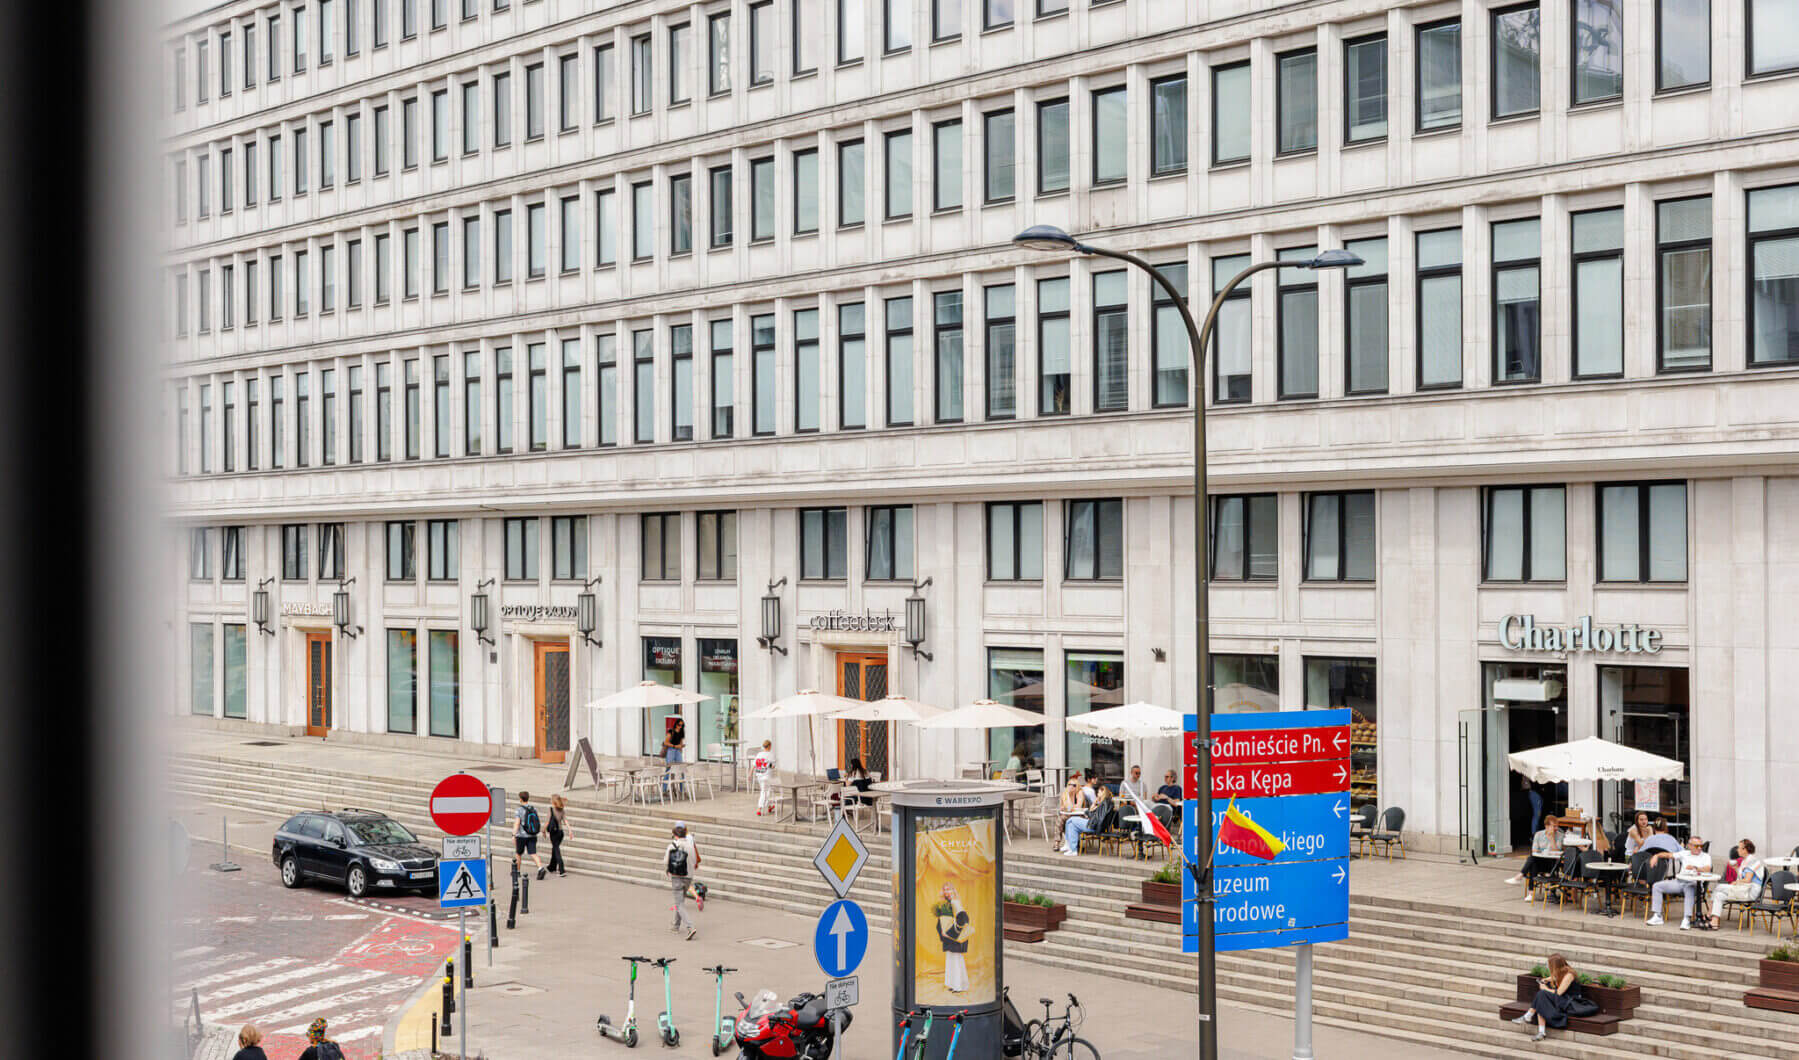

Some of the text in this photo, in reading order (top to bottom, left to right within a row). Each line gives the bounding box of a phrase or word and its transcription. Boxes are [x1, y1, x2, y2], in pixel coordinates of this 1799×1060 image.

[809, 607, 896, 631] coffeedesk
[1498, 614, 1663, 653] Charlotte
[1192, 733, 1326, 758] ódmieście Pn.
[1251, 769, 1292, 794] Kępa
[944, 796, 982, 804] WAREXPO
